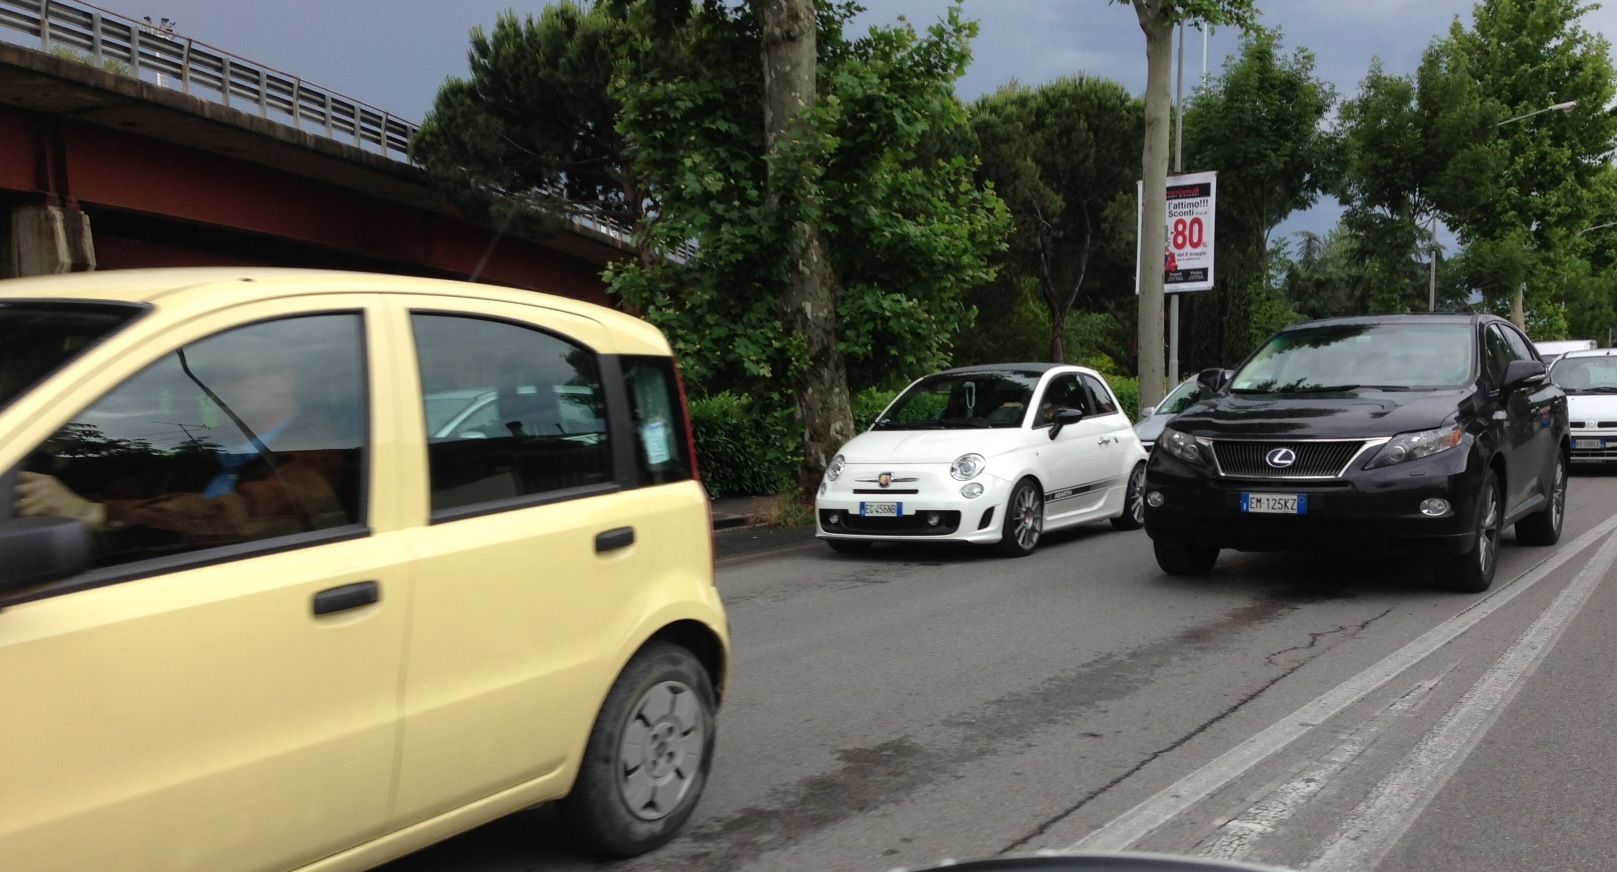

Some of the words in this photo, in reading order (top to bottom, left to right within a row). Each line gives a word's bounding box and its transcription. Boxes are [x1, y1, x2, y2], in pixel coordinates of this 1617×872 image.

[1168, 209, 1194, 218] Sconti
[1250, 497, 1262, 509] EM
[1266, 498, 1297, 511] 125KZ
